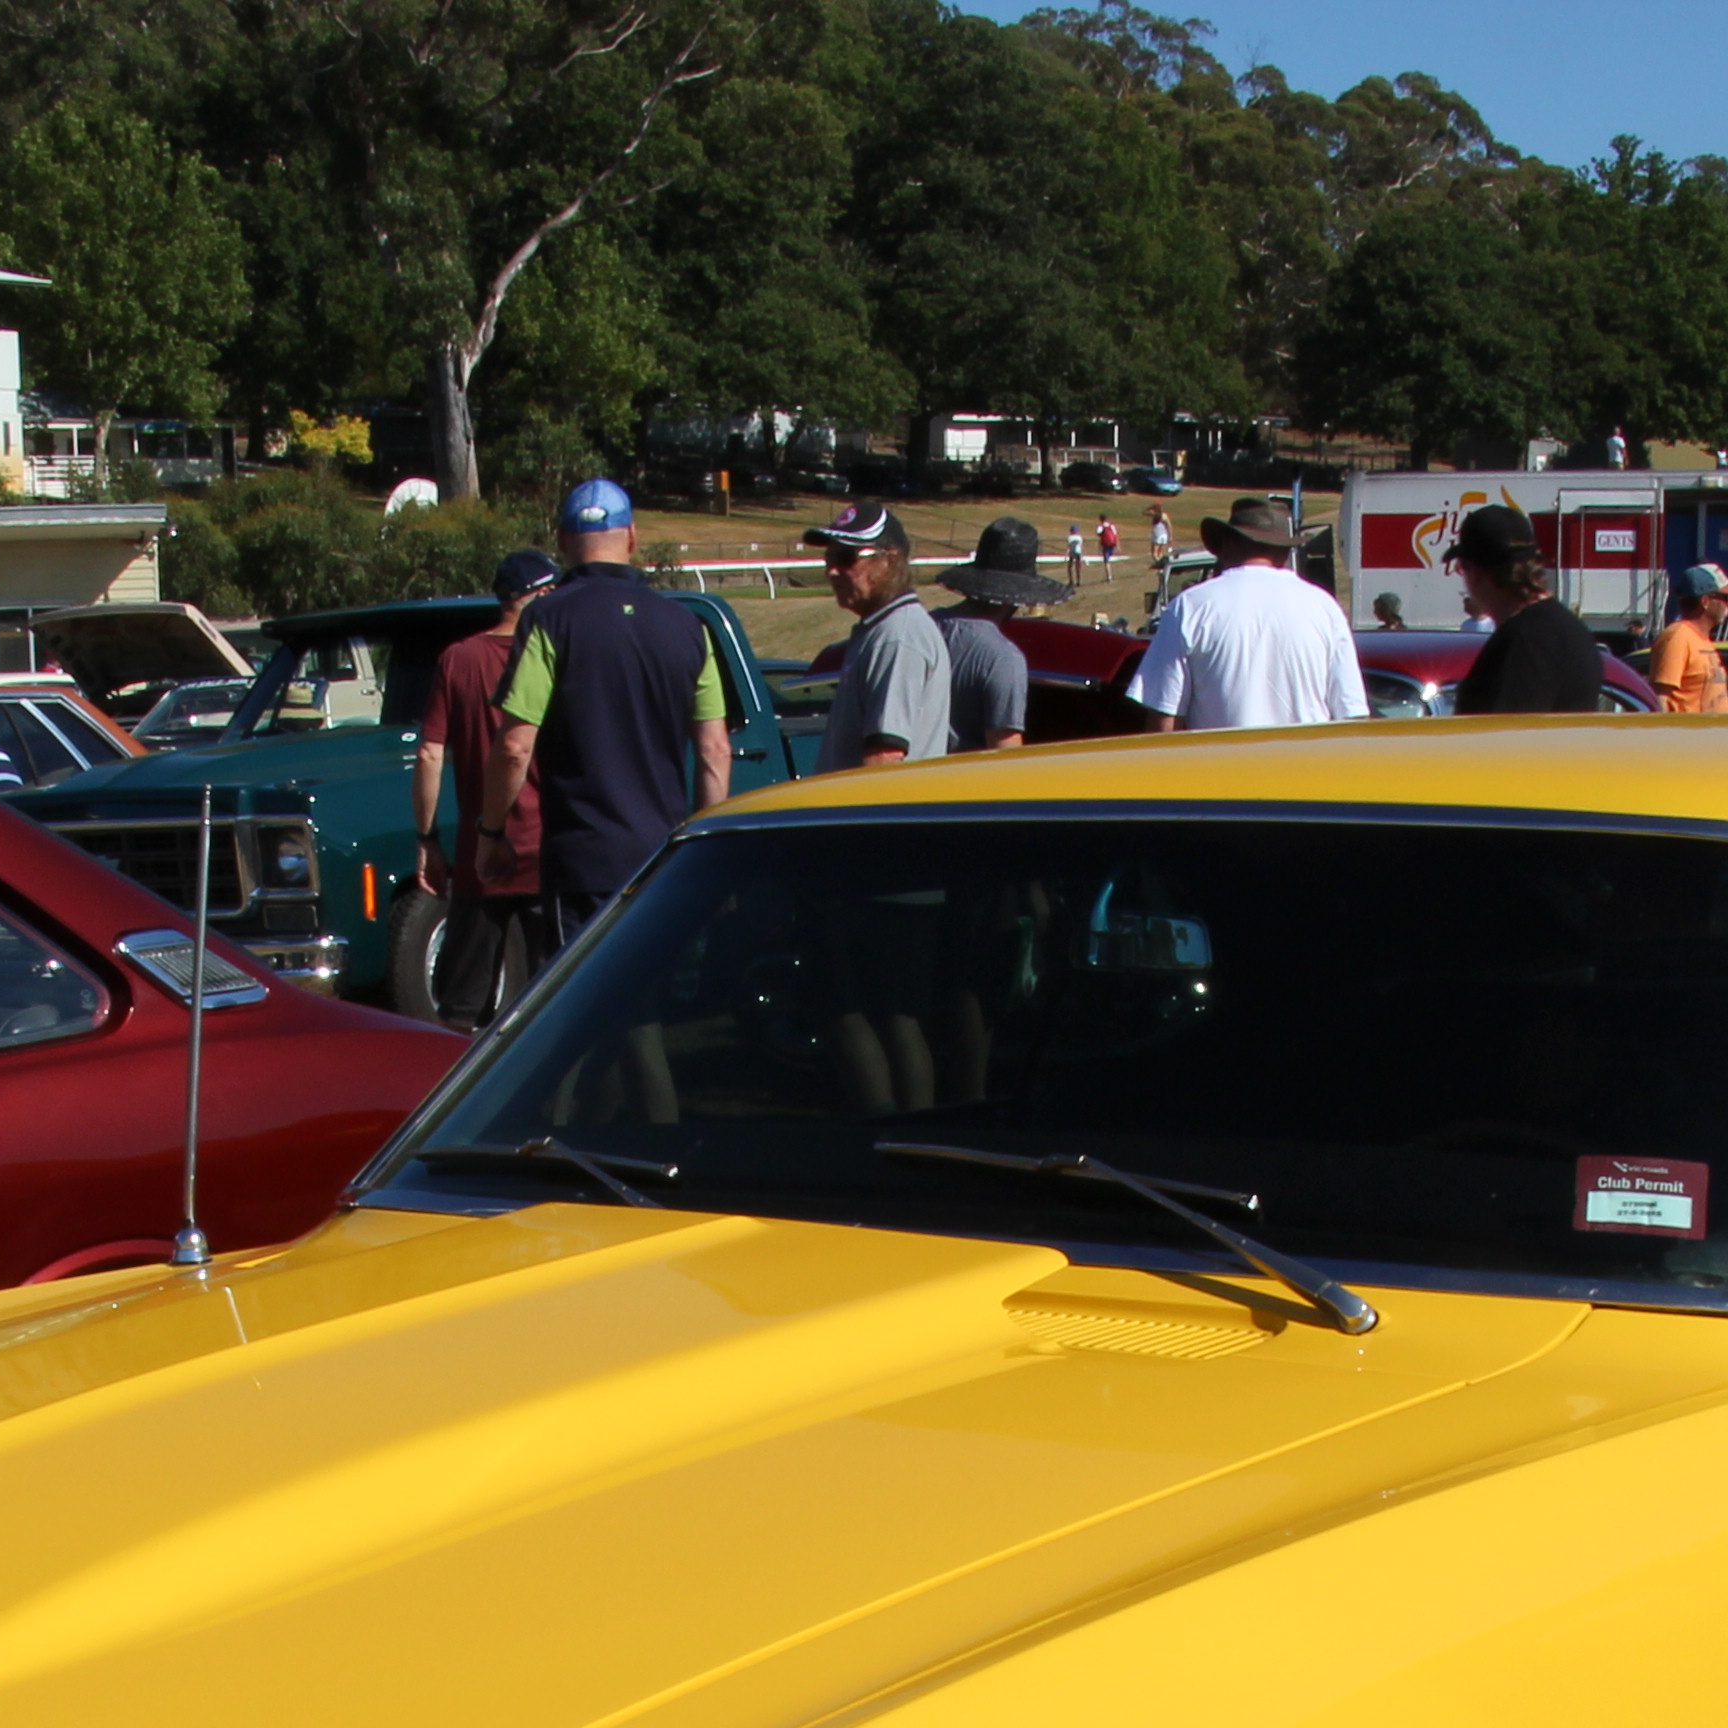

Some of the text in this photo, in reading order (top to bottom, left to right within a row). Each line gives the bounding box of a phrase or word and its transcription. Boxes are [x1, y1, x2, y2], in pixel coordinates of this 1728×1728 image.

[1597, 534, 1636, 548] GENTS
[1597, 1176, 1684, 1193] Club Permit
